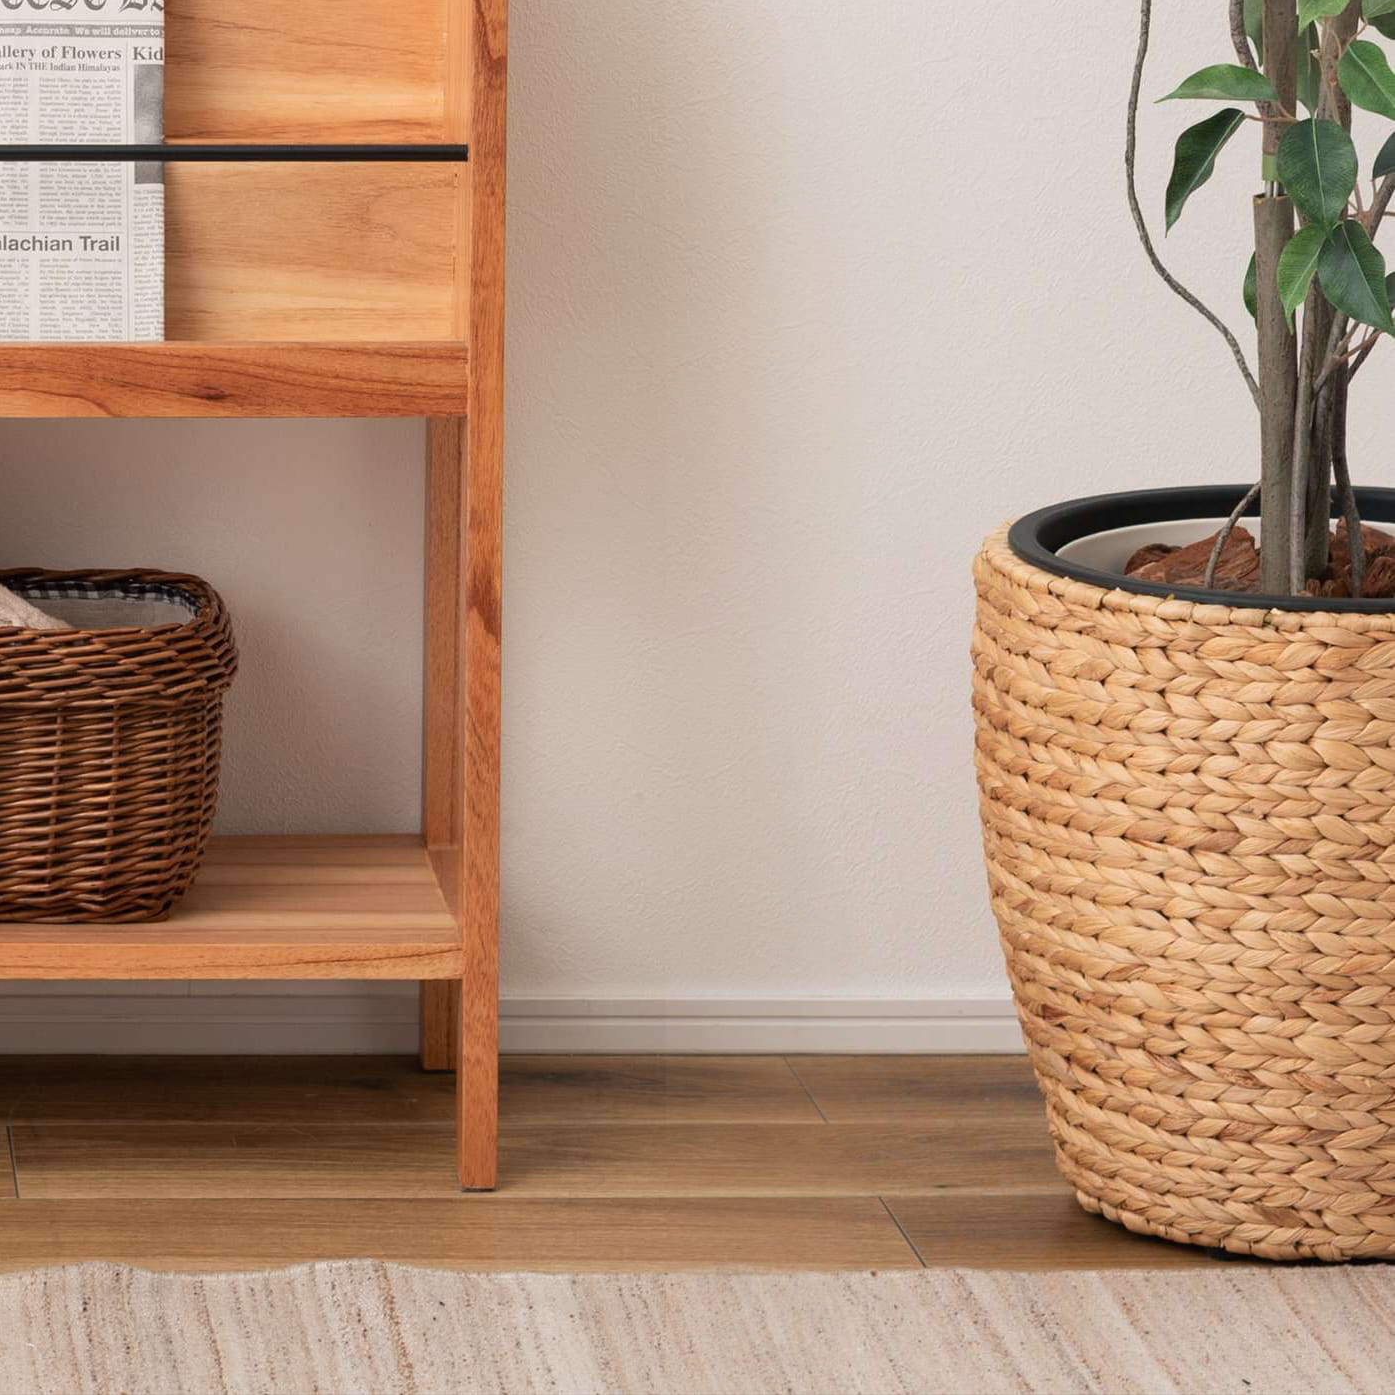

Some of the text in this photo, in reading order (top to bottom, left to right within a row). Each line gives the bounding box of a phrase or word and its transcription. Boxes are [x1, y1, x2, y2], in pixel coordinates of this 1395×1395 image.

[26, 26, 70, 35] Accurate
[75, 27, 90, 35] We
[92, 27, 111, 35] will
[113, 27, 149, 36] deliver
[150, 28, 159, 36] to
[41, 46, 56, 59] of
[62, 46, 122, 60] Flowers
[16, 63, 26, 71] IN
[29, 63, 47, 71] THE
[50, 63, 74, 71] Indian
[78, 63, 121, 73] Himalayas
[79, 236, 120, 251] Trail
